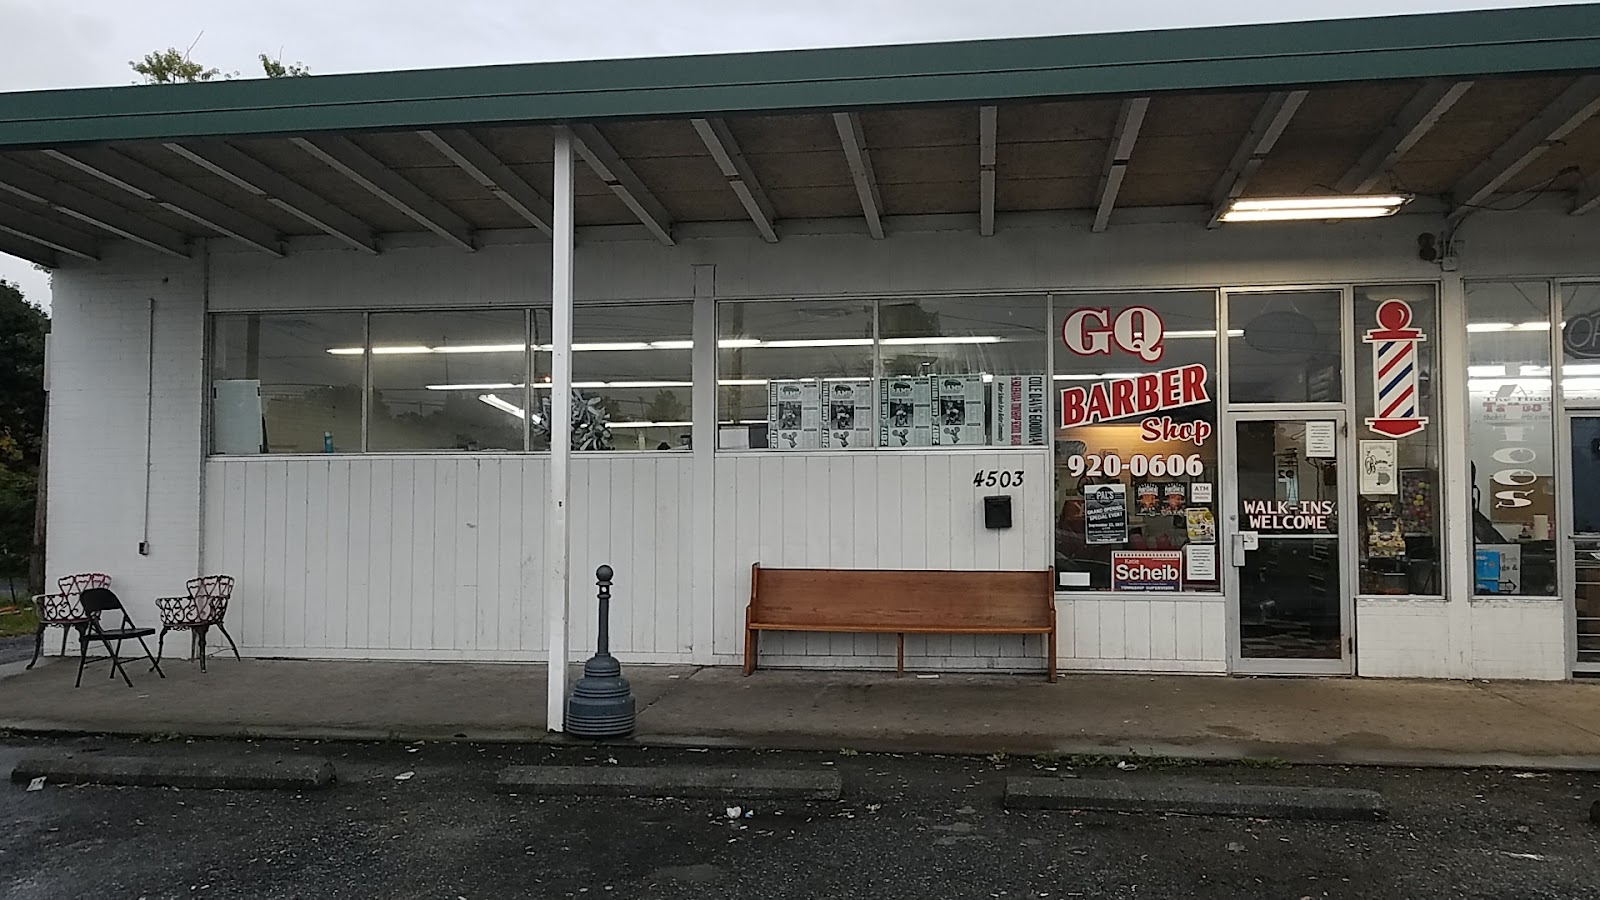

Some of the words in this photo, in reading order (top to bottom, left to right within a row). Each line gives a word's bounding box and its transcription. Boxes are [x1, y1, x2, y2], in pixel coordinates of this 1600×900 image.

[1063, 306, 1164, 364] GQ
[1029, 376, 1043, 392] COLE
[1060, 363, 1211, 428] BARBER
[1141, 417, 1211, 445] Shop
[1068, 454, 1203, 477] 920-0606
[973, 469, 1025, 488] 4503
[1096, 490, 1115, 500] PAL'S
[1243, 500, 1333, 515] WALK-INS
[1249, 515, 1328, 530] WELCOME
[1116, 564, 1178, 580] Scheib
